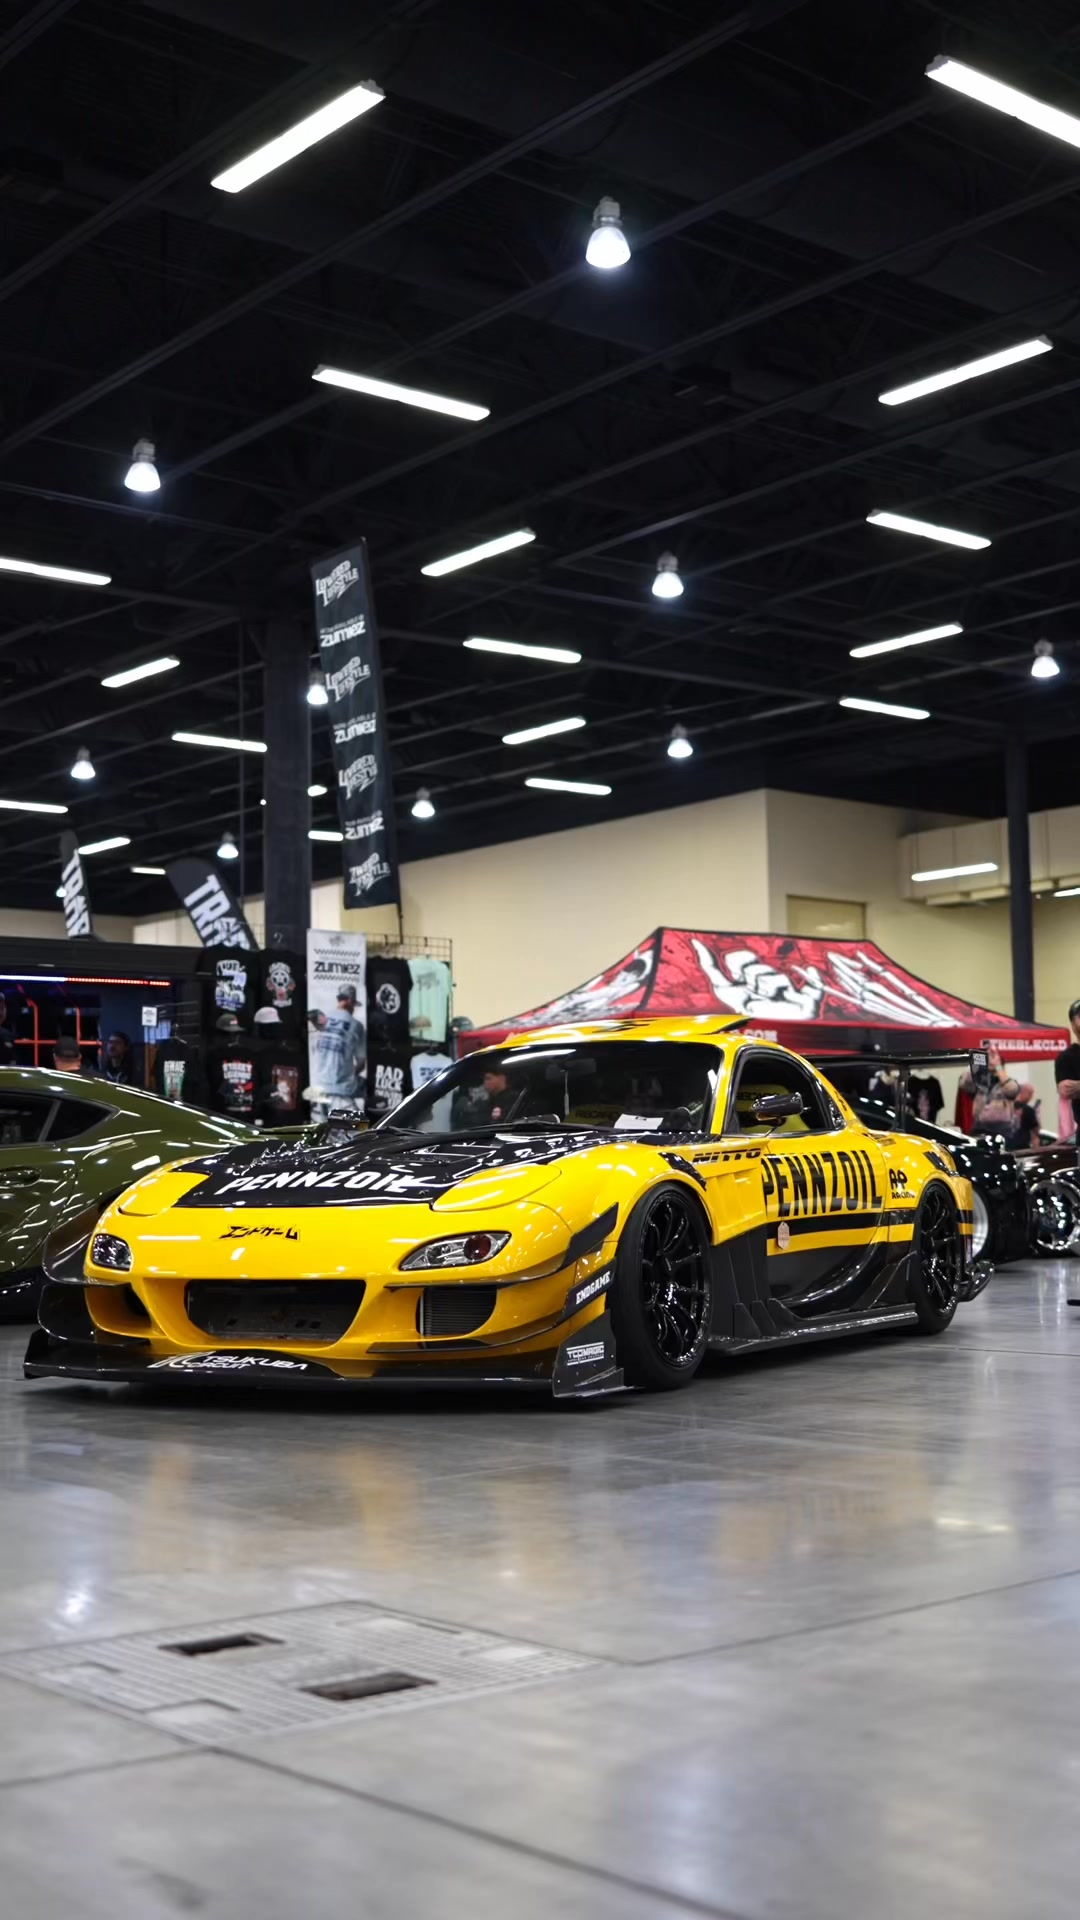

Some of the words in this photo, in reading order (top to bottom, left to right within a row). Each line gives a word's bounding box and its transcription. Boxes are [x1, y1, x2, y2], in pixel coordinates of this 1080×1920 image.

[314, 961, 361, 975] zumiez
[376, 1064, 404, 1081] BAD
[692, 1148, 761, 1163] NITTO
[214, 1171, 410, 1195] PENNZOIL
[761, 1150, 883, 1218] PENNZOIL
[576, 1271, 610, 1304] ENDGAME
[206, 1355, 308, 1370] TSUKUBA
